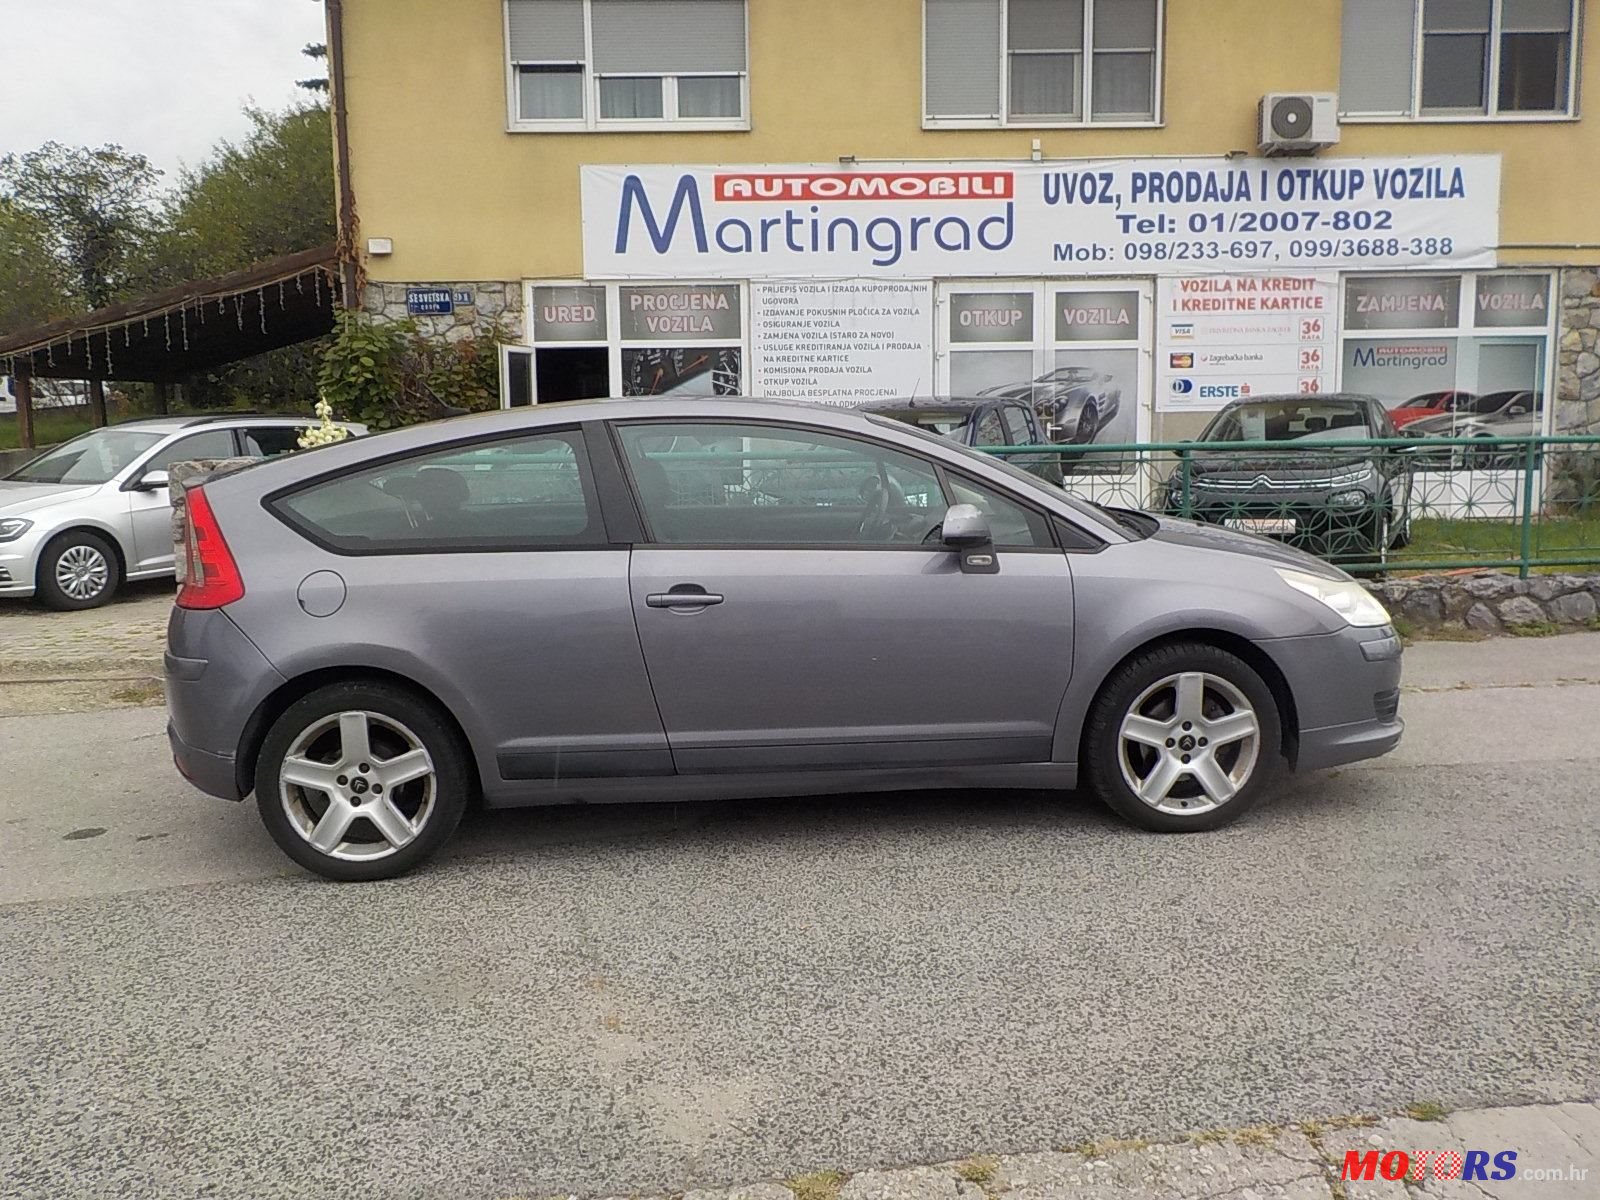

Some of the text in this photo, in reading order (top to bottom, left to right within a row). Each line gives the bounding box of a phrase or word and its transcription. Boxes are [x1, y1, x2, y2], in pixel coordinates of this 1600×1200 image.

[723, 176, 1006, 198] AUTOMOBILI
[1043, 166, 1466, 210] UVOZ, PRODAJA I OTKUP VOZILA
[614, 173, 1015, 267] Martingrad
[1115, 209, 1393, 235] Tel: 01/2007-802
[1053, 237, 1453, 262] Mob: 098/233-697, 099/3688-388
[762, 285, 797, 294] PRIJEPIS
[799, 285, 826, 293] VOZILA
[832, 285, 860, 293] IZRADA
[862, 284, 928, 293] KUPOPRODAJNIH
[1180, 278, 1316, 293] VOZILA NA KREDIT
[630, 294, 730, 311] PROCJENA
[762, 297, 799, 305] UGOVORA
[1172, 296, 1323, 312] I KREDITNE KARTICE
[1356, 295, 1445, 313] ZAMJENA
[1479, 293, 1545, 311] VOZILA
[543, 304, 596, 323] URED
[762, 308, 805, 317] IZDAVANJE
[806, 308, 847, 316] POKUSNIH
[881, 308, 891, 316] ZA
[893, 308, 920, 316] VOZILA
[959, 310, 1023, 326] OTKUP
[1063, 308, 1130, 325] VOZILA
[646, 315, 714, 333] VOZILA
[762, 320, 841, 328] OSIGURANJE VOZILA
[1302, 319, 1321, 335] 36
[762, 332, 800, 340] ZAMJENA
[829, 331, 858, 340] (STARO
[859, 331, 869, 339] ZA
[870, 331, 895, 339] NOVO)
[763, 343, 794, 351] USLUGE
[795, 343, 852, 351] KREDITIRANJA
[886, 342, 922, 350] PRODAJA
[763, 355, 775, 363] NA
[776, 355, 815, 363] KREDITNE
[1301, 348, 1320, 365] 36
[1352, 347, 1448, 370] Martingrad
[808, 366, 844, 374] PRODAJA
[845, 366, 873, 374] VOZILA
[763, 378, 818, 386] OTKUP VOZILA
[1300, 379, 1319, 394] 36
[763, 389, 806, 398] (NAJBOLJA
[807, 389, 853, 397] BESPLATNA
[1199, 385, 1239, 398] ERSTE
